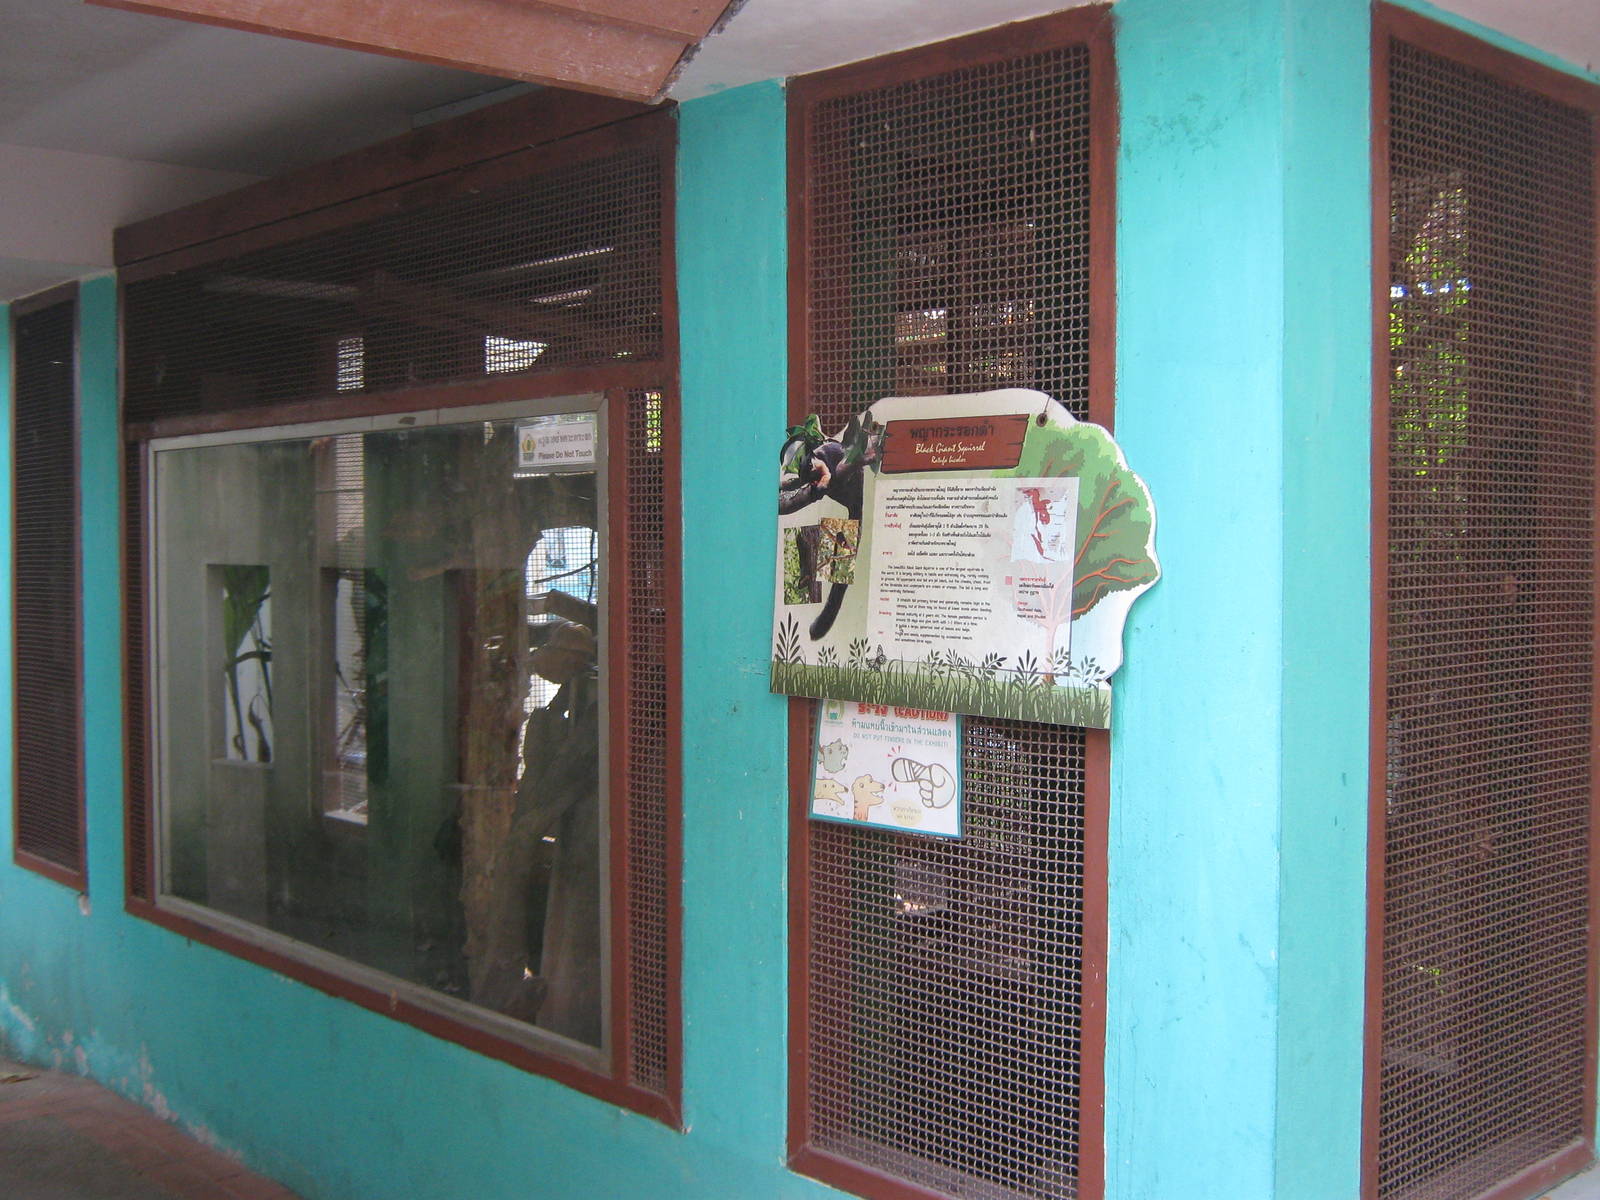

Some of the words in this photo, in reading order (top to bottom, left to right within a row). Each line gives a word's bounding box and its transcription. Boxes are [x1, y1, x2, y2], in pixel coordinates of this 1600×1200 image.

[911, 420, 994, 441] พญากระรอกดำ
[538, 452, 555, 460] Please
[556, 450, 563, 459] Do
[564, 450, 575, 458] Not
[575, 449, 593, 458] Touch
[915, 443, 935, 454] Black
[936, 442, 957, 454] Giant
[957, 441, 986, 455] Squirrel
